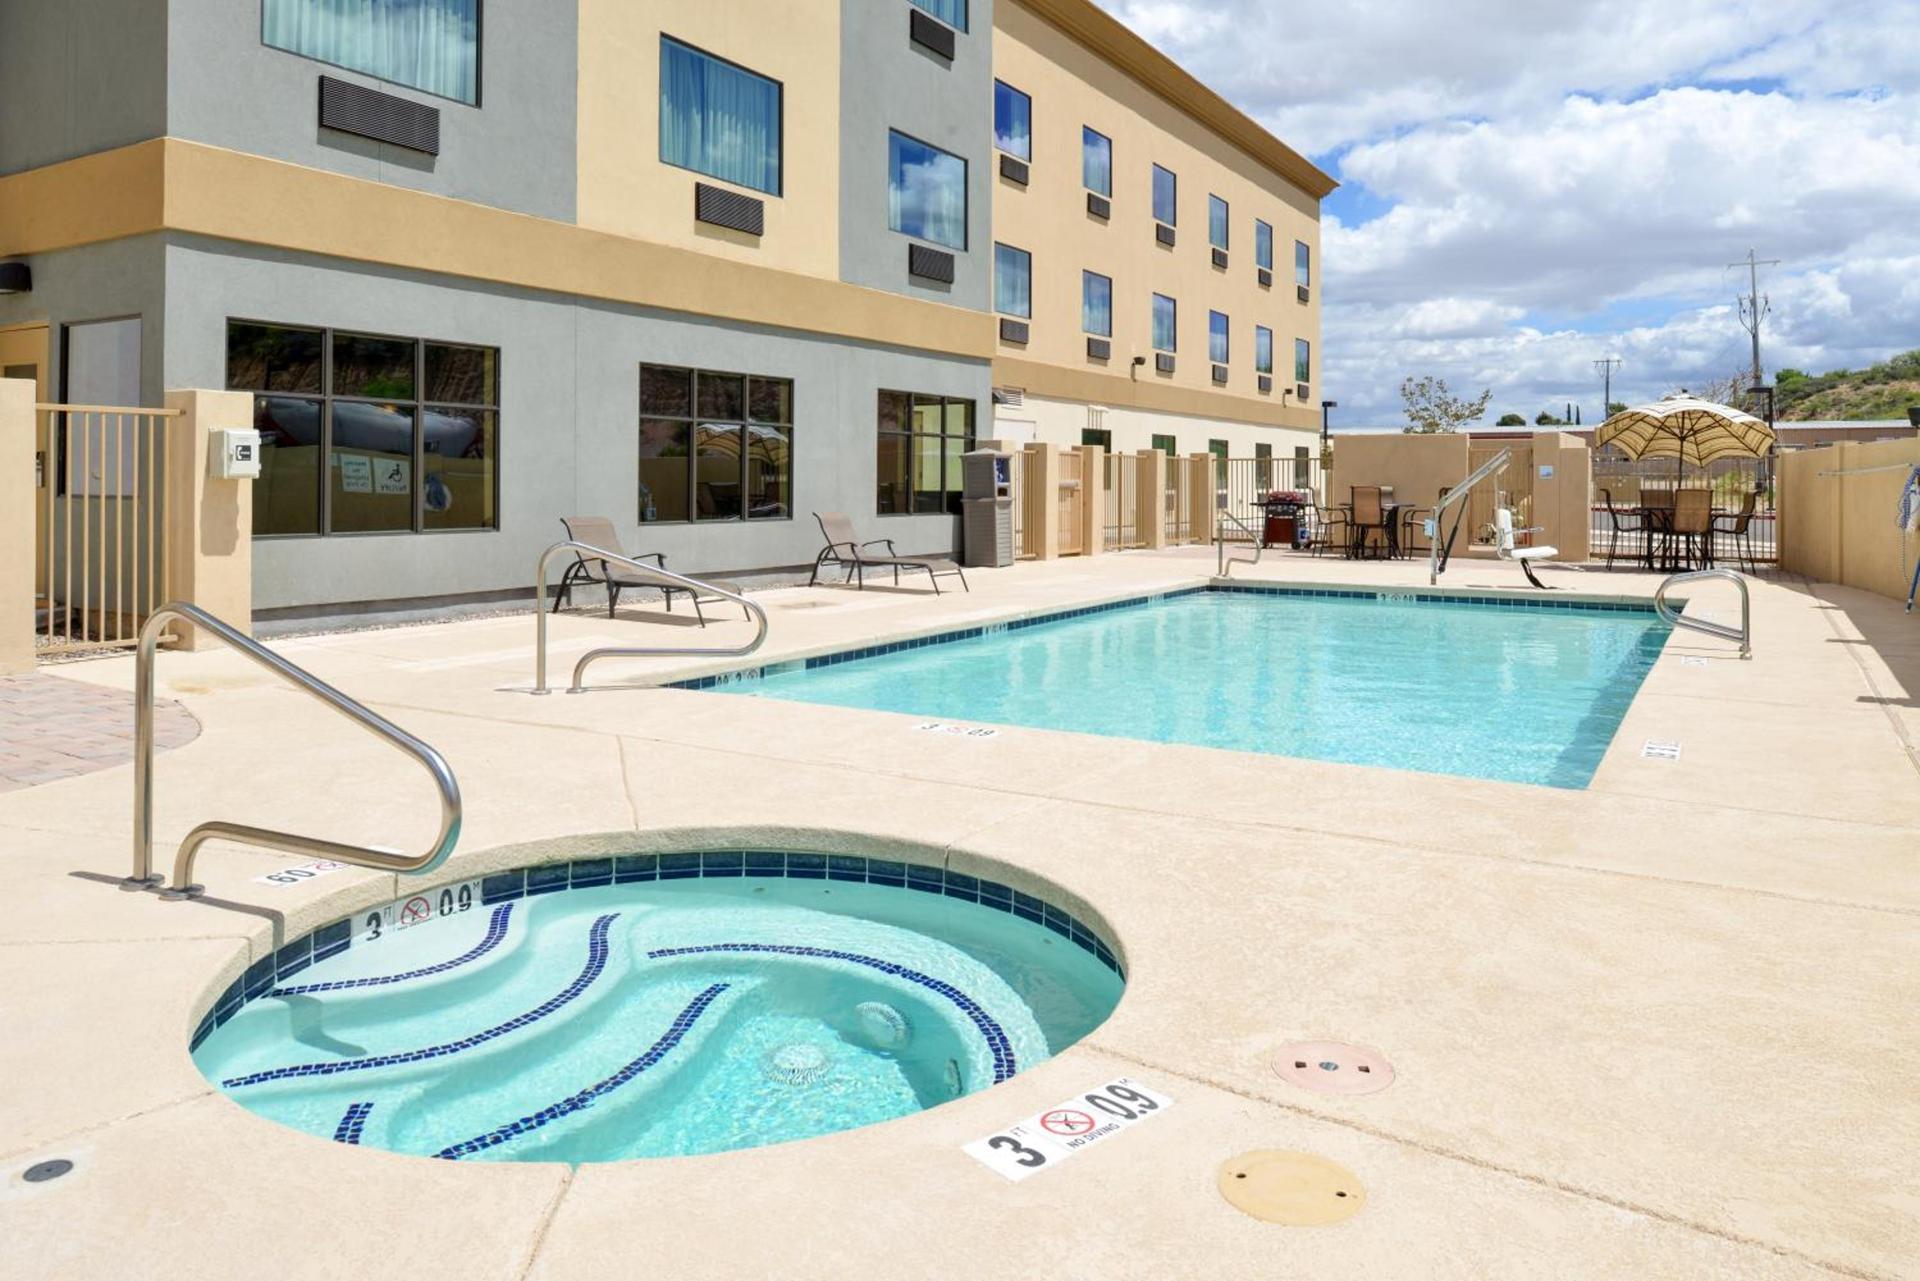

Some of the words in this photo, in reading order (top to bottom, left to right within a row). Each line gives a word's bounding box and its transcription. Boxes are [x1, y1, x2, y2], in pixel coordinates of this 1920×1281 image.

[366, 911, 381, 941] 3
[1084, 1084, 1159, 1120] 0.9
[1009, 1126, 1029, 1138] FT
[1066, 1137, 1086, 1149] NO
[1086, 1122, 1121, 1141] DIVING
[988, 1135, 1047, 1168] 3
